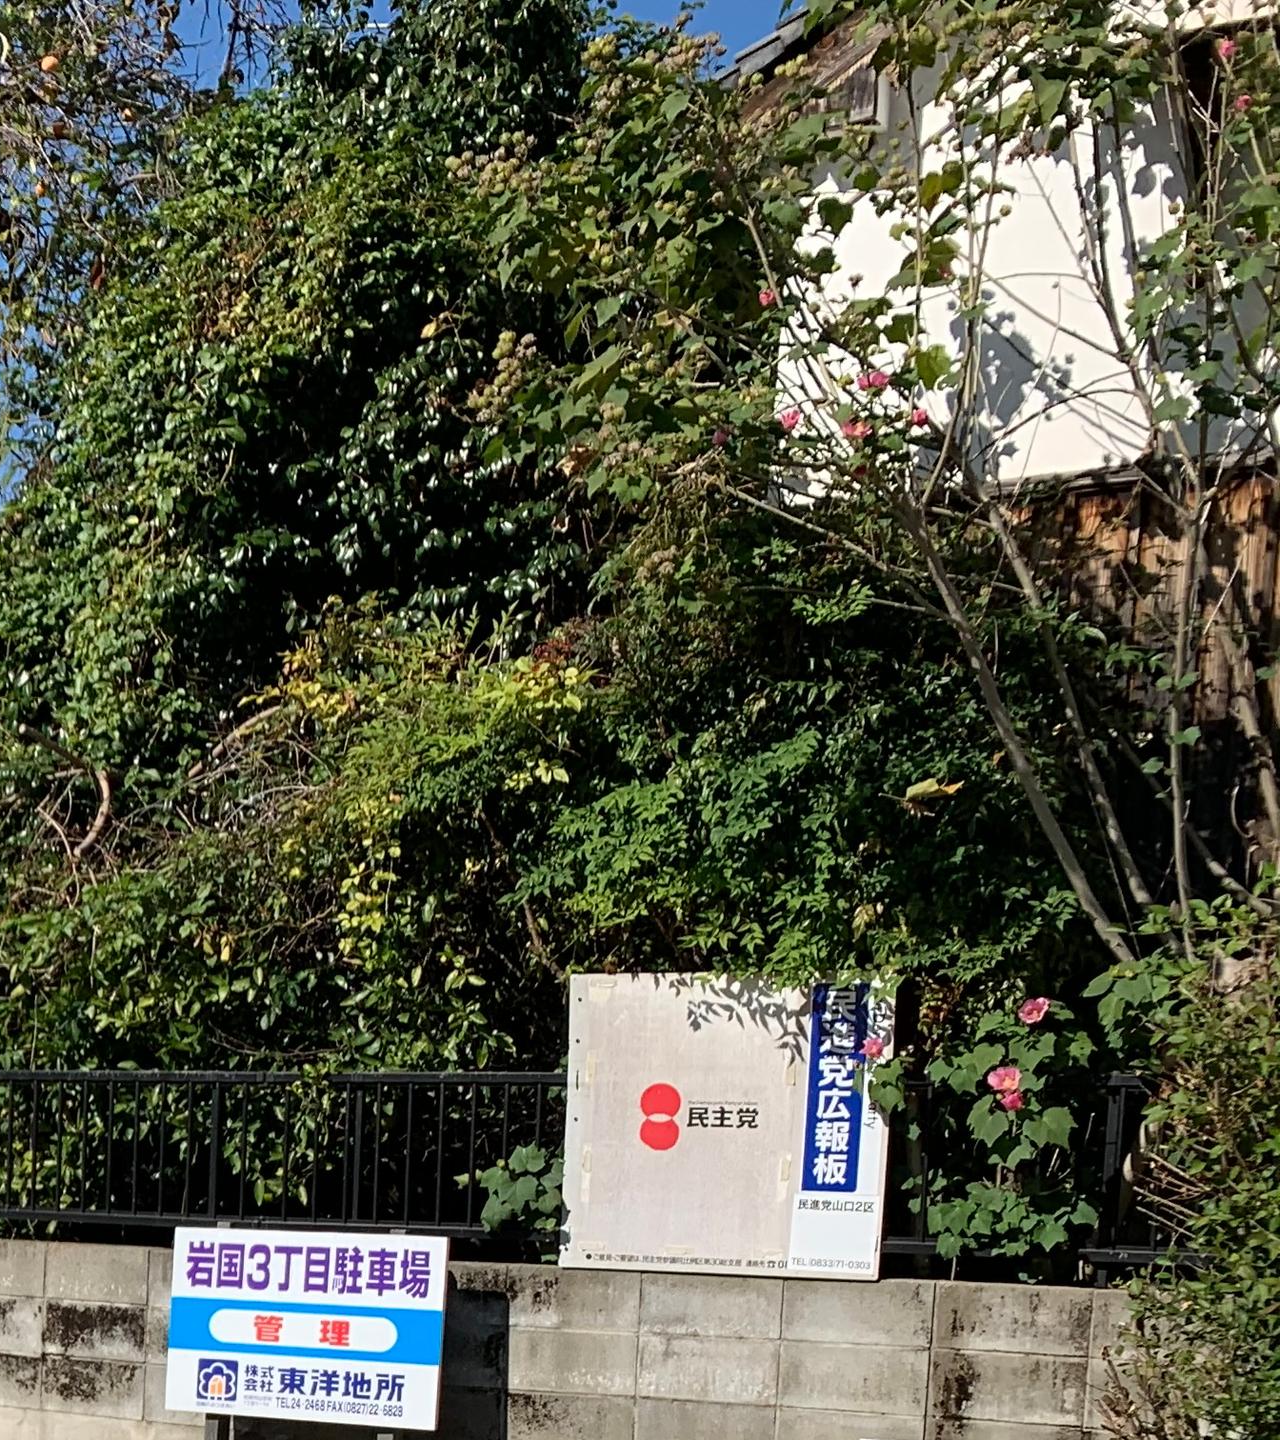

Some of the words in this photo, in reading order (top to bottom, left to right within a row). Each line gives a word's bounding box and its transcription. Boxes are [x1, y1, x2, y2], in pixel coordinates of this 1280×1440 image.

[687, 1106, 759, 1129] 民主党
[798, 1199, 875, 1213] 民進党山口2区
[187, 1241, 431, 1298] 岩国3丁目駐車場
[791, 1257, 807, 1266] TEL
[253, 1315, 350, 1347] 管理
[278, 1367, 405, 1402] 東洋地所
